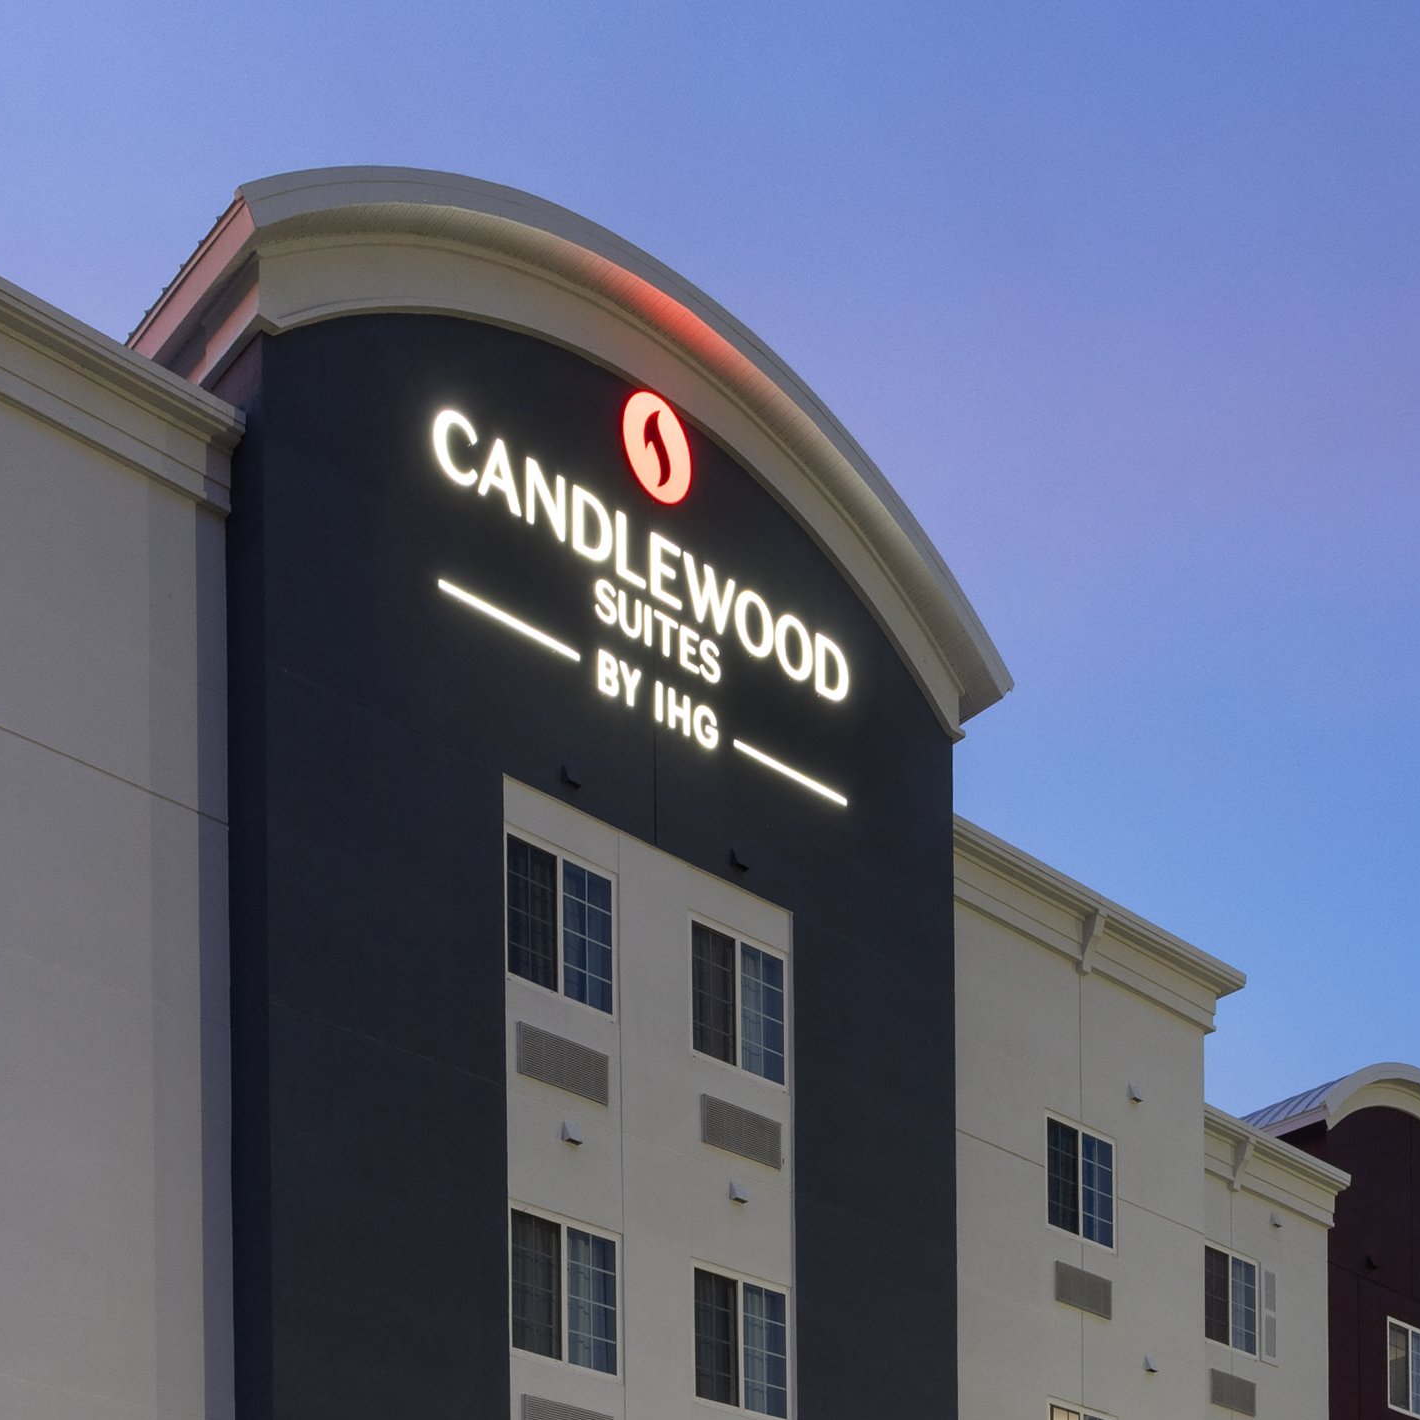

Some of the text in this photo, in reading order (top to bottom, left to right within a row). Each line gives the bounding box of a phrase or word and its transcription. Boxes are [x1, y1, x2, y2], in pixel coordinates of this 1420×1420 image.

[432, 409, 849, 702] CANDLEWOOD
[594, 578, 721, 684] SUITES
[597, 648, 719, 750] BY IHG
